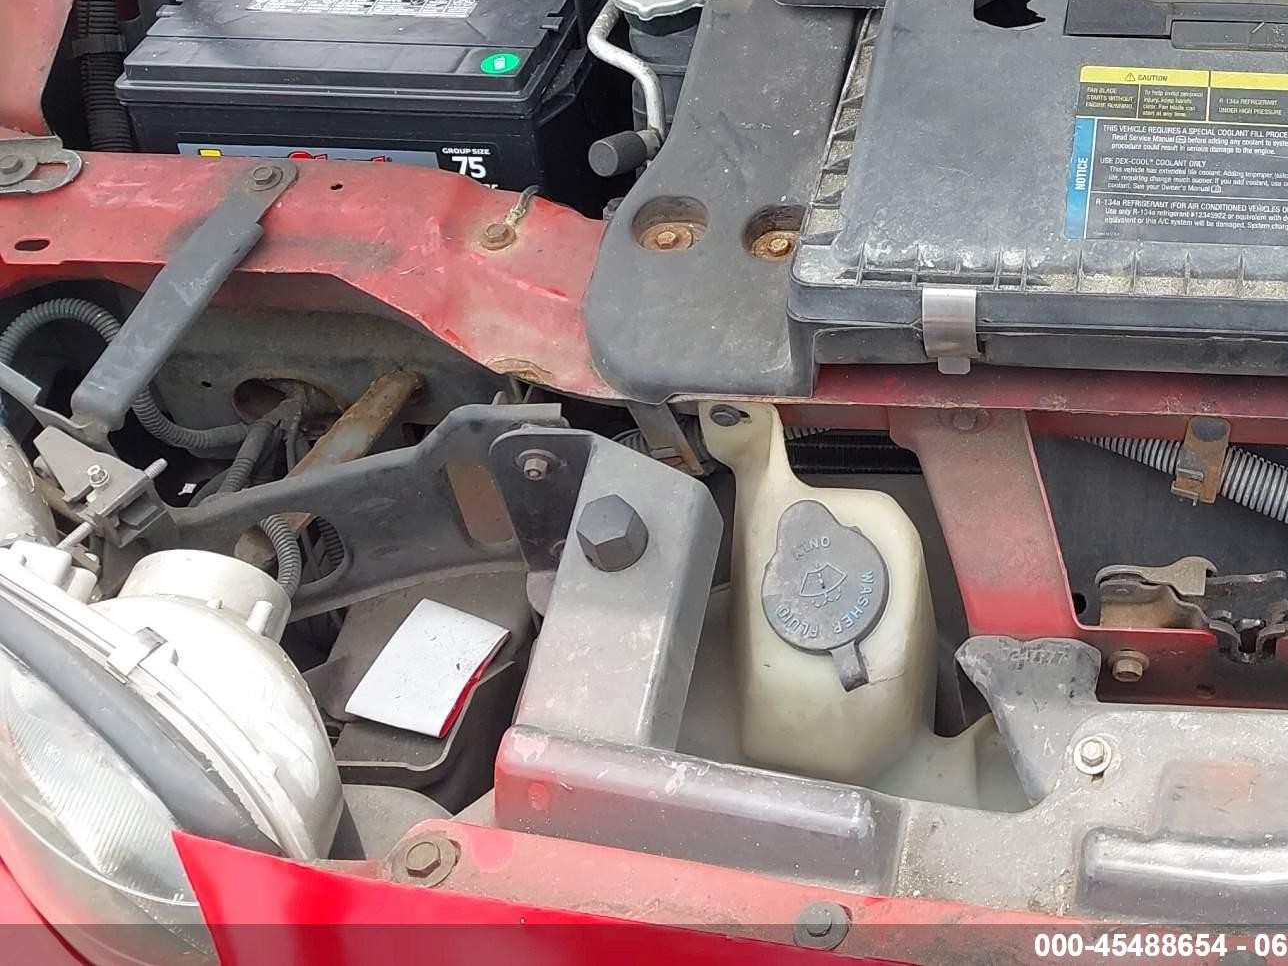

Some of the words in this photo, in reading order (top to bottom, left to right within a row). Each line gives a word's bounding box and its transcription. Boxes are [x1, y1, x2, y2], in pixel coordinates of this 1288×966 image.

[1138, 73, 1168, 82] CAUTION
[1103, 124, 1118, 132] THIS
[1119, 125, 1147, 133] VEHICLE
[1148, 126, 1180, 134] REQUIRES
[1188, 127, 1215, 135] SPECIAL
[1217, 129, 1249, 137] COOLANT
[451, 156, 487, 179] 75
[1100, 156, 1114, 164] USE
[1155, 158, 1187, 167] COOLANT
[1189, 160, 1206, 168] ONLY
[1075, 157, 1088, 191] NOTICE
[1122, 200, 1168, 209] REFRIGERANT
[1186, 202, 1198, 210] AIR
[1200, 203, 1246, 212] CONDITIONED
[1248, 205, 1280, 213] VEHICLES
[792, 536, 831, 562] ONLY
[833, 571, 875, 634] WASHER
[775, 604, 820, 639] FLUID
